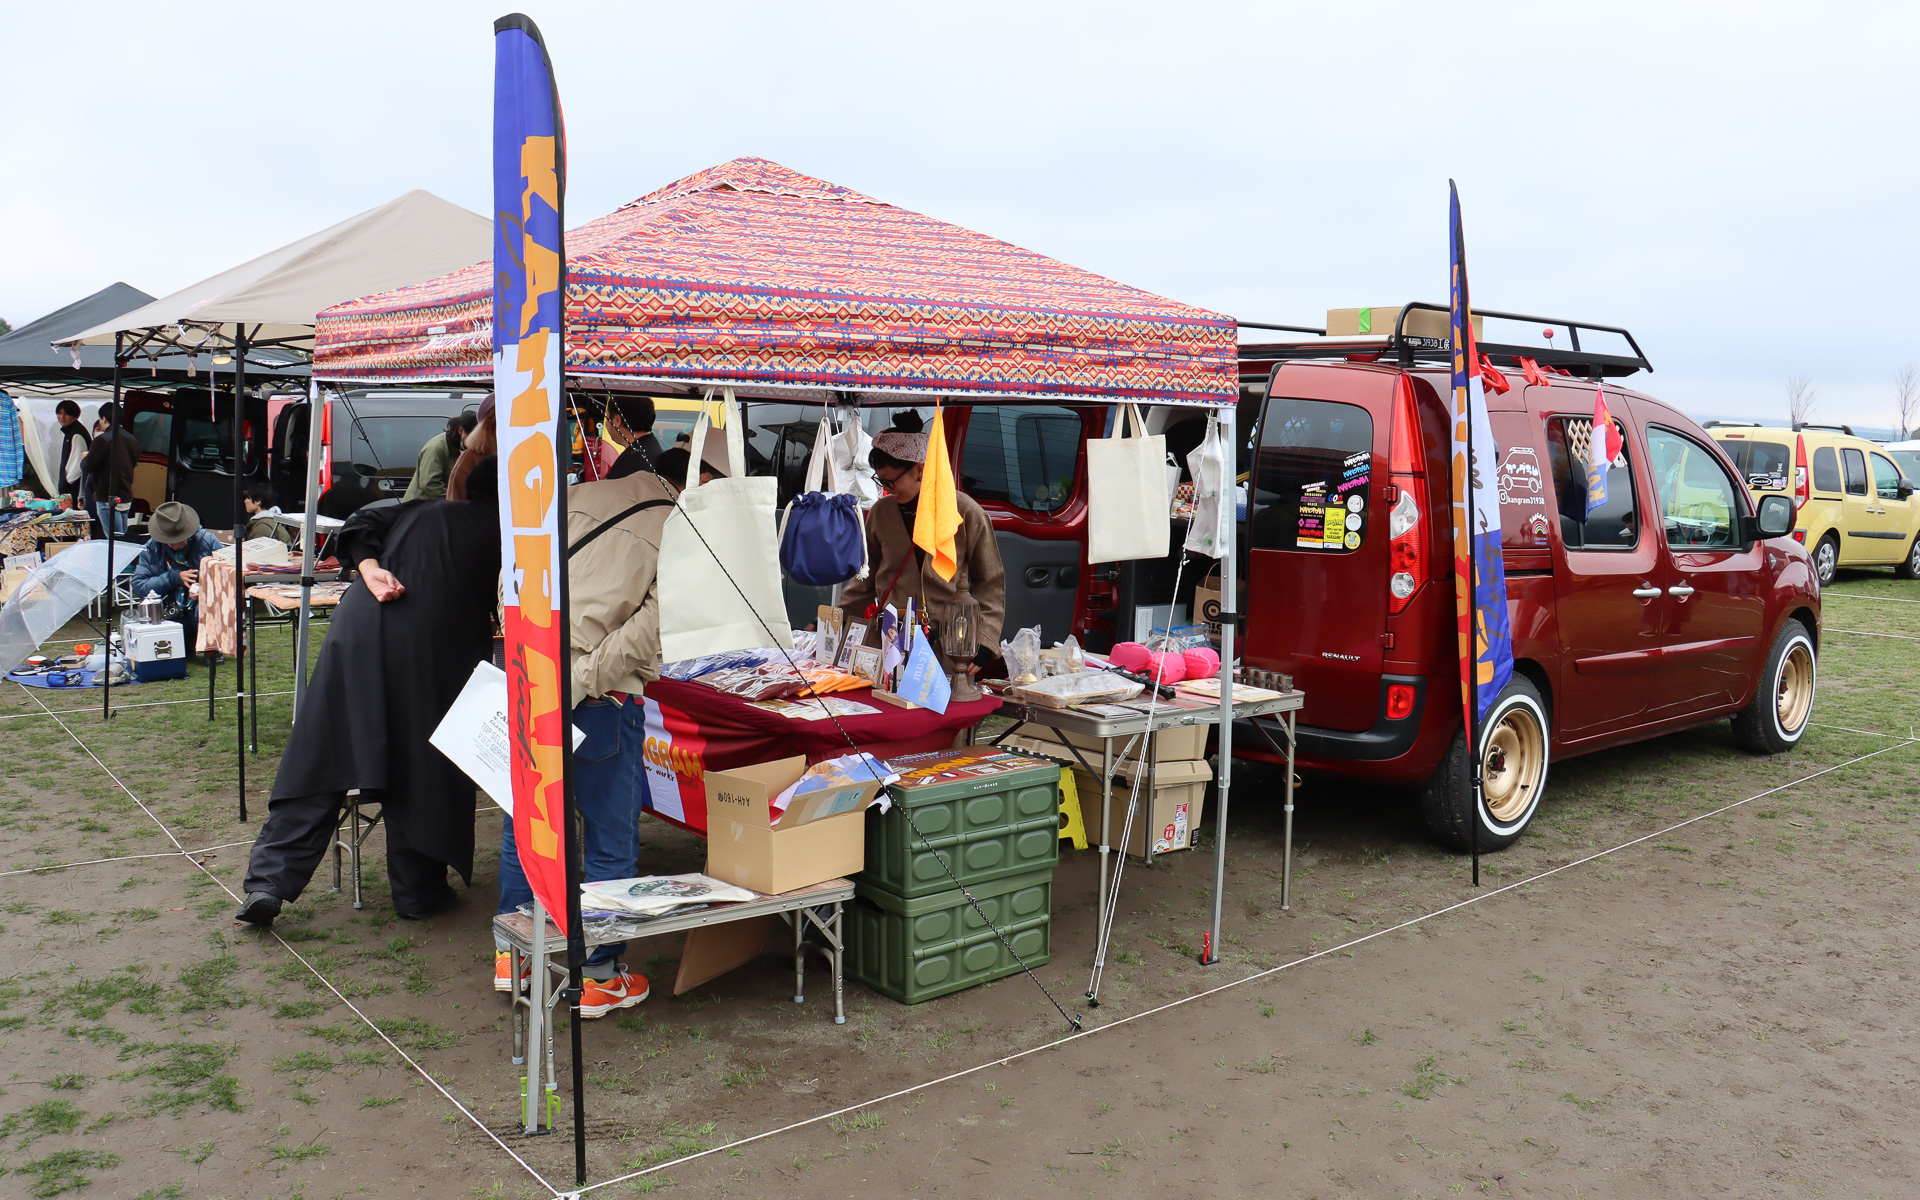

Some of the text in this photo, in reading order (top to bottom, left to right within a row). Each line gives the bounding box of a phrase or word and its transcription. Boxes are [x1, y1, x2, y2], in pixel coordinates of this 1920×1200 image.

[508, 135, 563, 862] KANGRAM
[1508, 496, 1545, 505] kangram31938
[1322, 652, 1361, 661] RENAULT
[480, 721, 493, 735] TOP
